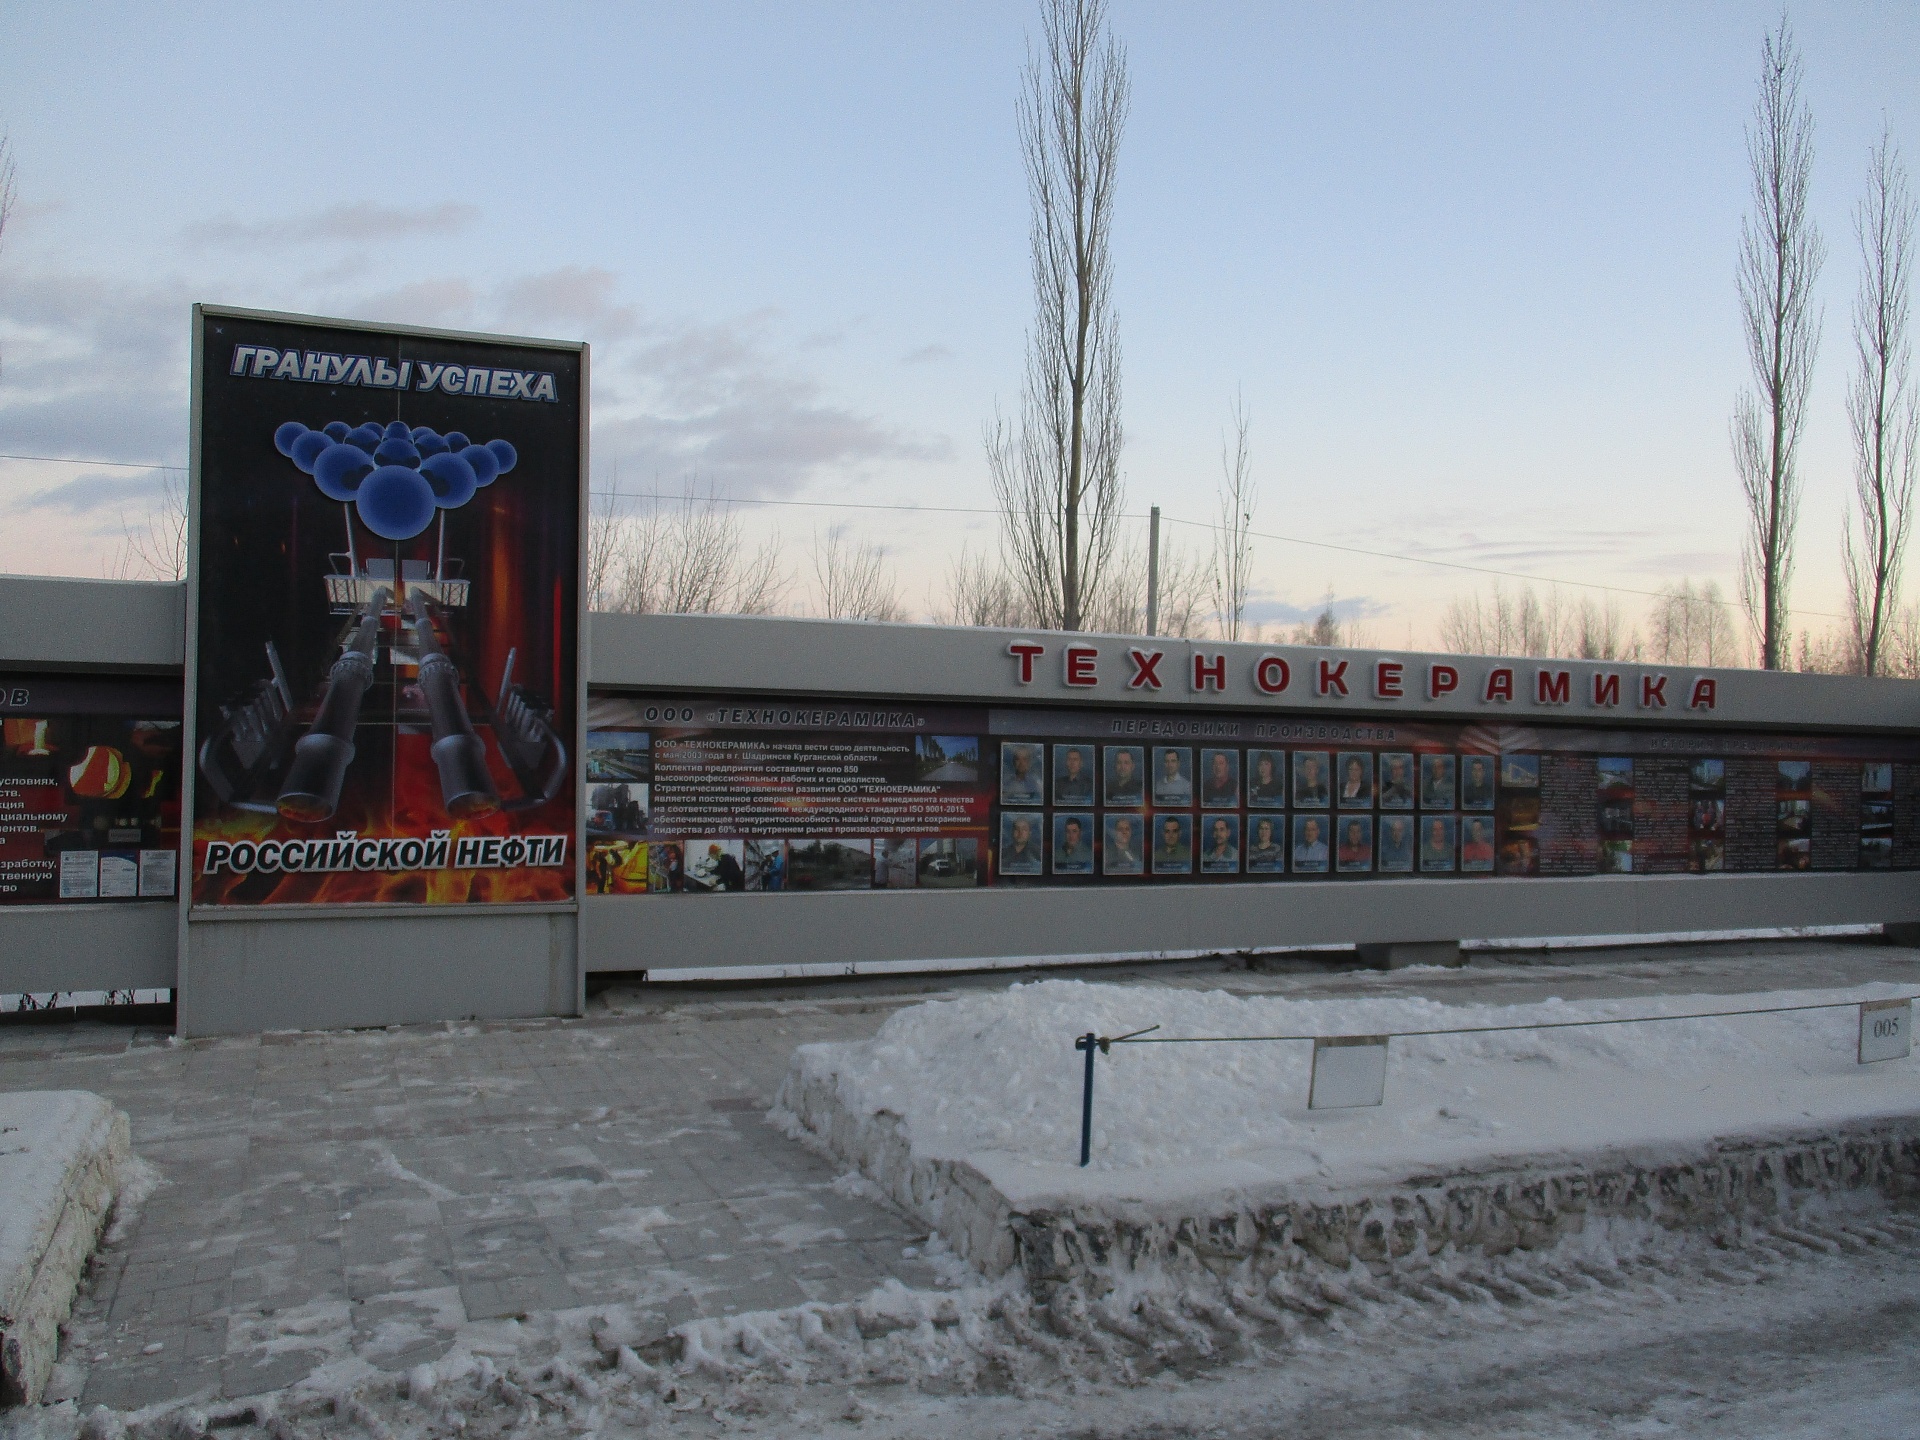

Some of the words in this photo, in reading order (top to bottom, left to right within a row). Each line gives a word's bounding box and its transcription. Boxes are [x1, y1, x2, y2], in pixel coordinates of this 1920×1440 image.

[231, 344, 413, 389] ГРАНУЛЫ
[416, 361, 558, 402] УСПЕХА
[1008, 642, 1718, 709] ТЕХНОКЕРАМИКА
[645, 706, 694, 722] ООО
[706, 708, 925, 728] «ТЕХНОКЕРАМИКА»
[1112, 719, 1240, 736] ПЕРЕДОВИКИ
[1255, 724, 1396, 741] ПРОИЗВОДСТВА
[655, 740, 676, 748] ООО
[680, 740, 770, 750] «ТЕХНОКЕРАМИКА»
[682, 751, 702, 759] 2003
[742, 752, 791, 761] Шадринске
[793, 753, 842, 762] Курганской
[654, 763, 703, 771] Коллектив
[705, 765, 763, 773] предприятия
[843, 765, 859, 774] 850
[654, 774, 778, 783] высокопрофессиональных
[780, 775, 817, 783] рабочих
[654, 784, 727, 793] Стратегическим
[729, 786, 794, 794] направлением
[796, 786, 836, 794] развития
[837, 785, 858, 793] ООО
[860, 785, 941, 794] "ТЕХНОКЕРАМИКА"
[753, 796, 841, 804] совершенствование
[731, 805, 789, 813] требованиям
[791, 806, 863, 814] международного
[866, 806, 907, 814] стандарта
[909, 805, 924, 813] ISO
[654, 816, 733, 824] обеспечивающее
[735, 815, 840, 824] конкурентоспособность
[842, 815, 869, 823] нашей
[871, 816, 915, 824] продукции
[924, 816, 971, 824] сохранение
[0, 825, 40, 833] ентов.
[654, 827, 702, 835] лидерства
[752, 827, 804, 835] внутреннем
[835, 826, 894, 834] производства
[203, 830, 452, 874] РОССИЙСКОЙ
[454, 834, 568, 870] НЕФТИ
[1874, 1017, 1899, 1038] 005
